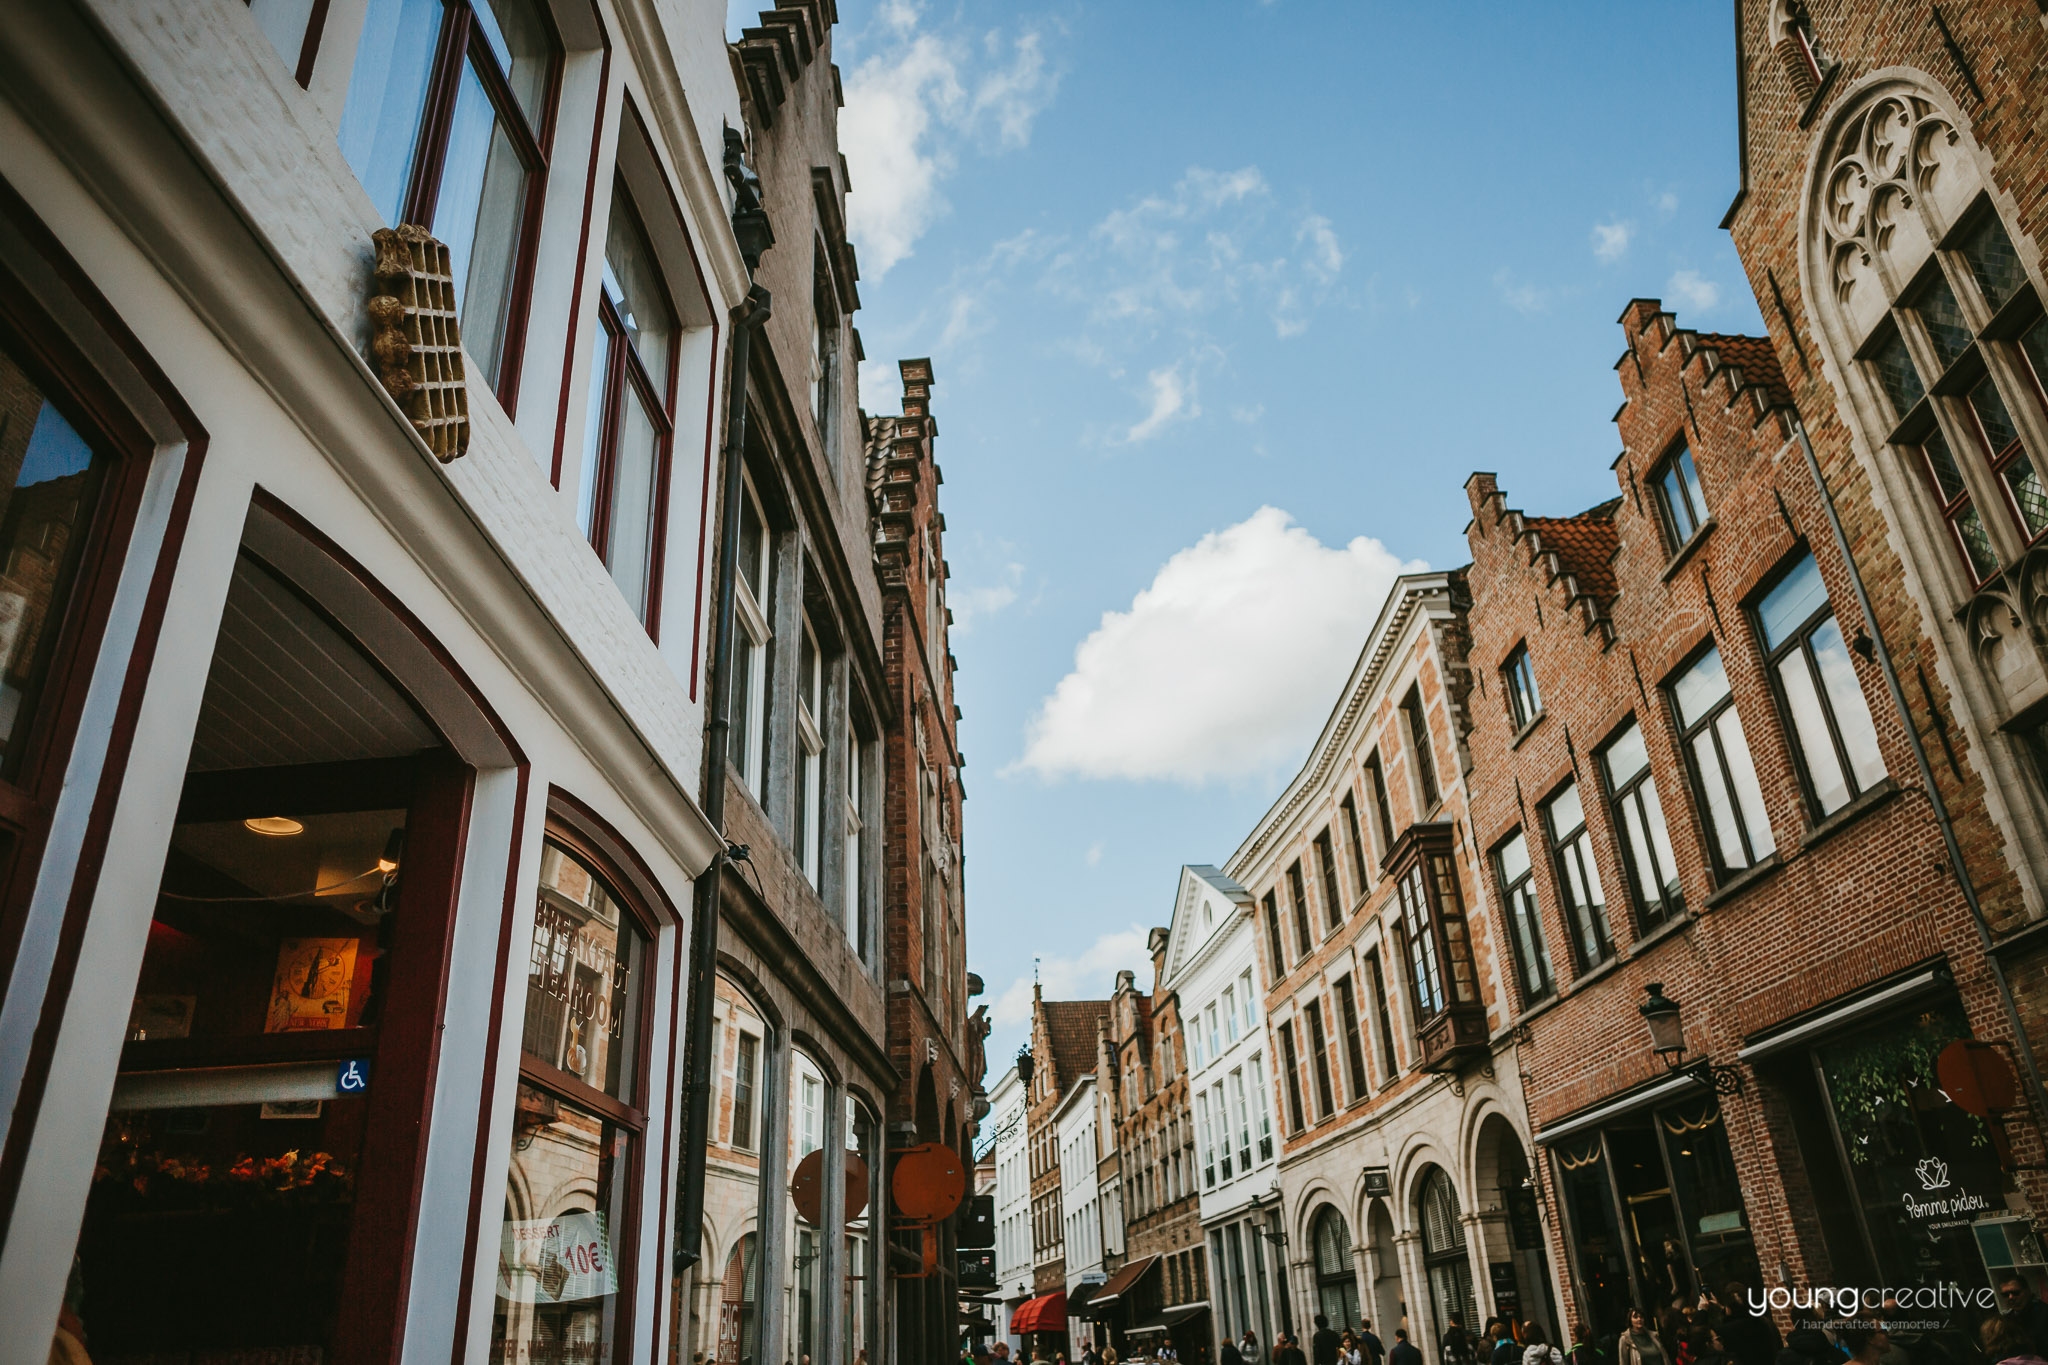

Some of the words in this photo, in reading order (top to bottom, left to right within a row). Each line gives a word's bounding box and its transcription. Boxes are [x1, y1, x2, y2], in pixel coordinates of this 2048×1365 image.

[535, 896, 631, 995] BREAKFAST
[537, 953, 623, 1039] TEAROOM
[1903, 1193, 1949, 1219] Pomme
[512, 1224, 560, 1241] DESSERT
[1941, 1219, 1969, 1229] SMILEMAKER
[565, 1242, 603, 1275] 10€
[720, 1303, 738, 1342] BIG
